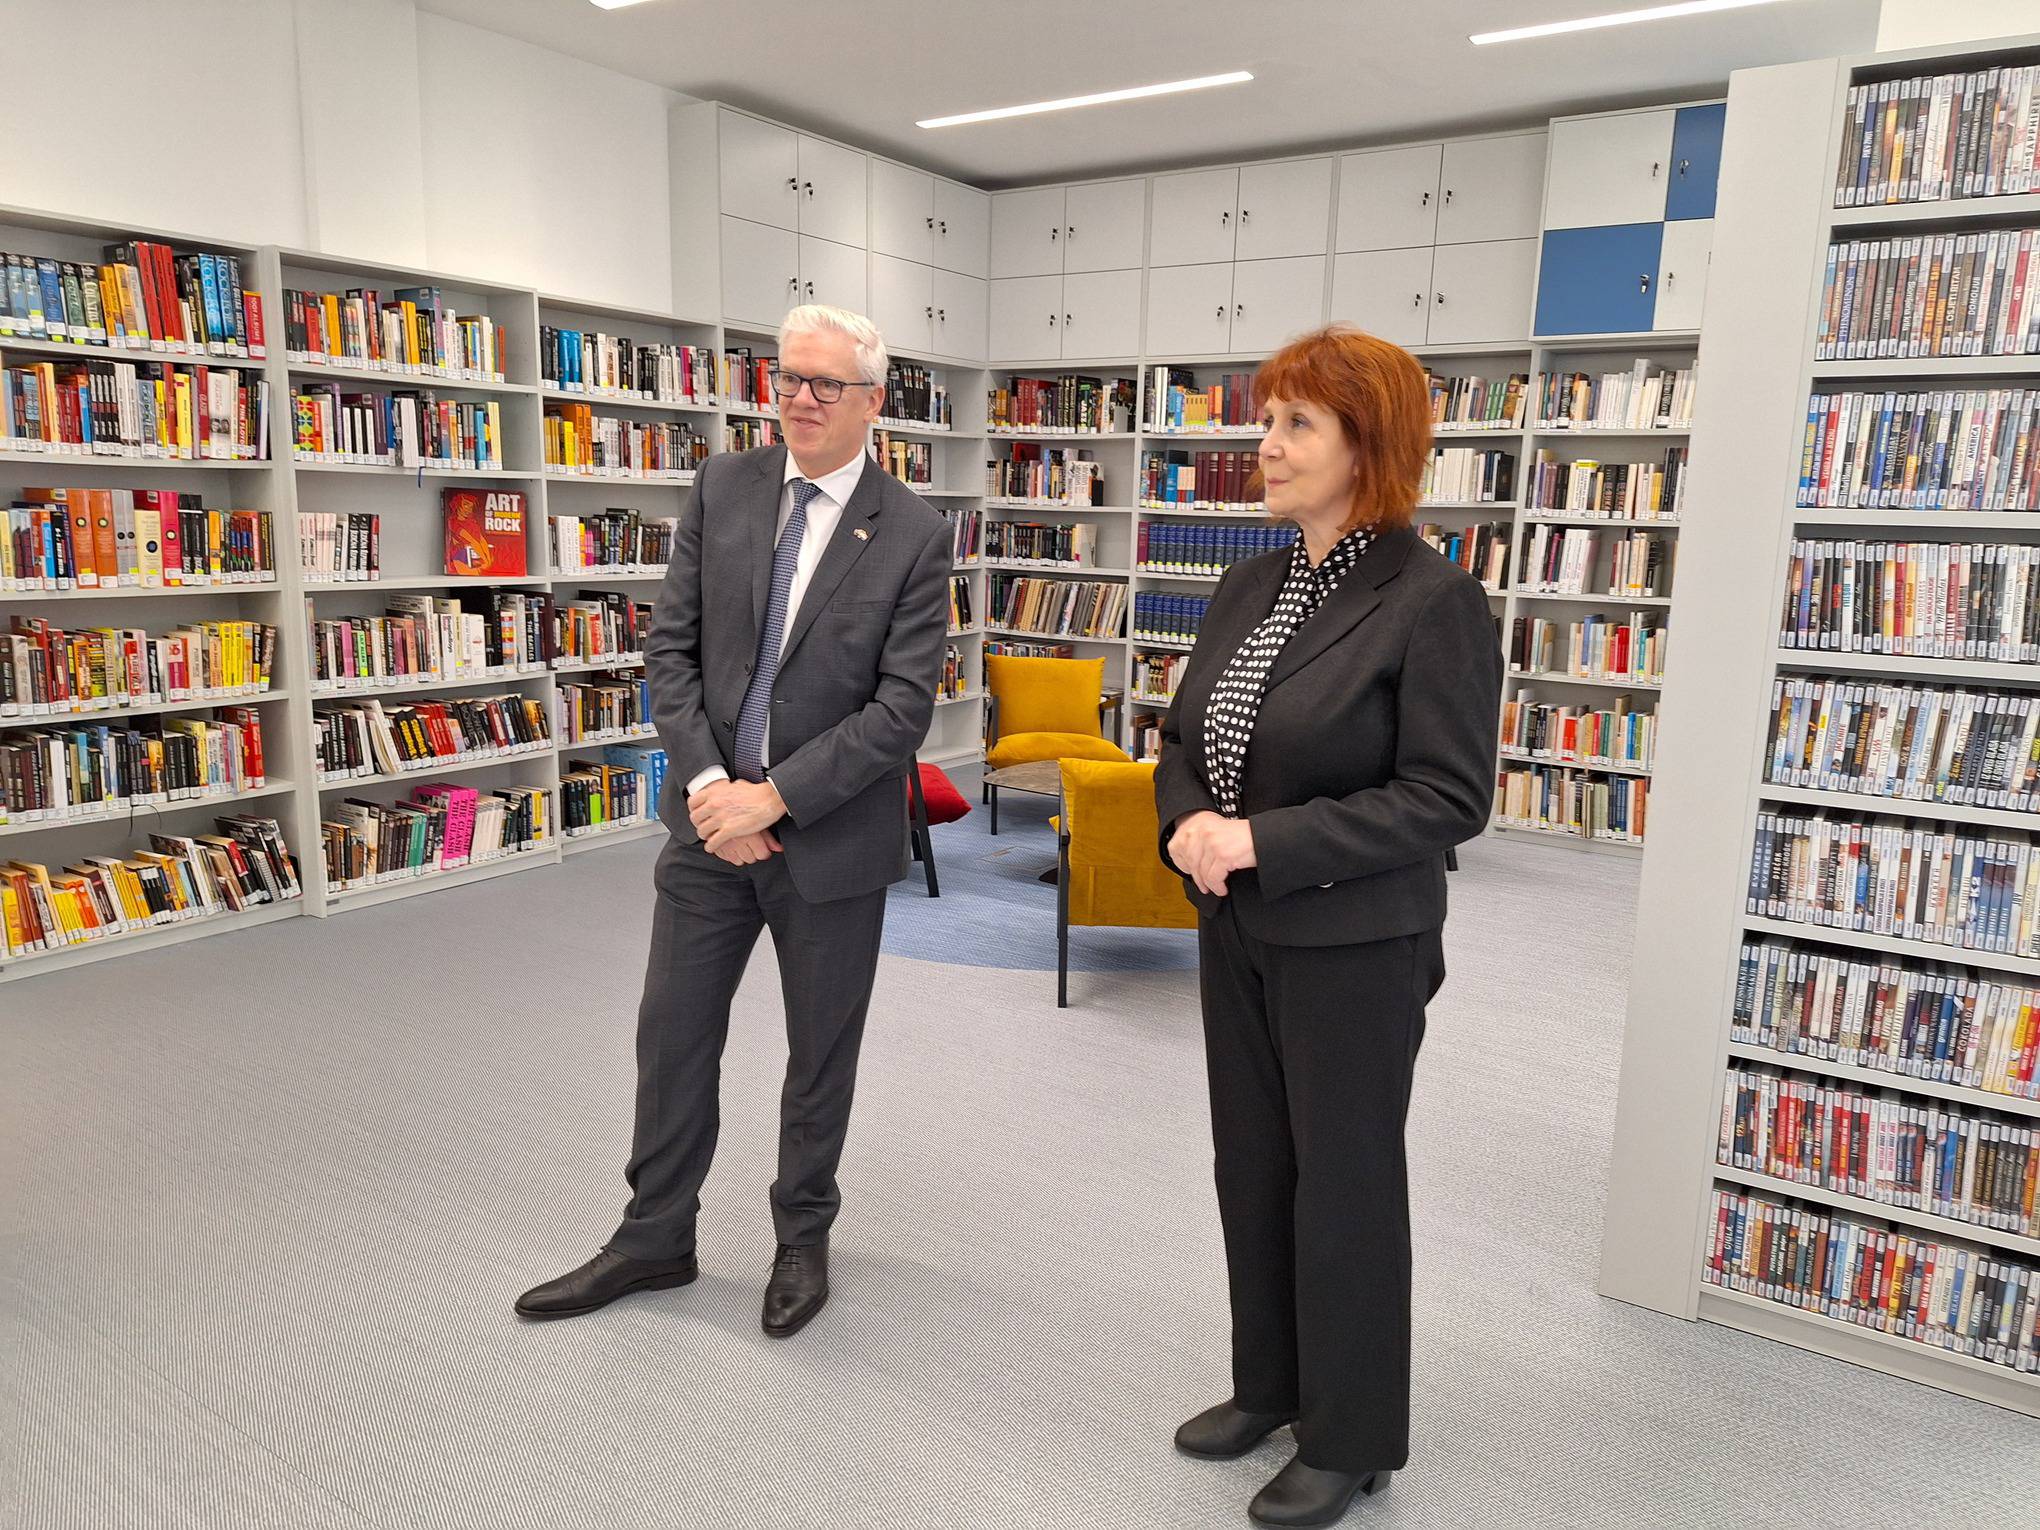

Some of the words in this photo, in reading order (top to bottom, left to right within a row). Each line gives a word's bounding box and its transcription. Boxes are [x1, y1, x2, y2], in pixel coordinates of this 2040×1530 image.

[2024, 95, 2039, 156] SAPPHIRES
[1950, 267, 1960, 292] RITAM
[1839, 276, 1854, 337] PHENOMENON
[1946, 294, 1956, 321] OSJETI
[1968, 276, 1980, 315] DOMOLJUB
[1897, 430, 1909, 465] HAVANA
[1967, 426, 1979, 459] AMERICA
[485, 493, 520, 511] ART
[485, 517, 521, 532] ROCK
[527, 635, 535, 661] BEATLES
[1900, 752, 1908, 766] LOVE
[1904, 724, 1913, 745] MERCY
[1955, 723, 1967, 752] ZLATU
[1886, 776, 1895, 791] MAX
[451, 801, 460, 820] THE
[459, 799, 467, 818] THE
[468, 797, 476, 816] THE
[447, 823, 456, 854] CLASH
[455, 821, 465, 853] CLASH
[464, 820, 474, 850] CLASH
[1751, 841, 1762, 887] EVEREST
[1761, 841, 1772, 888] EVEREST
[1772, 852, 1781, 879] DJEČAK
[1783, 842, 1791, 866] KROŠE
[1780, 868, 1788, 891] LIJEVI
[1929, 868, 1939, 907] MACBETH
[1969, 876, 1980, 897] K2
[1766, 974, 1775, 1011] DANKINJA
[1834, 986, 1844, 1013] PEHARA
[1831, 1015, 1840, 1033] VITEZ
[1938, 1018, 1949, 1043] granica
[1957, 1007, 1973, 1052] ČOKOLADA
[1735, 1125, 1745, 1137] 127
[1902, 1273, 1912, 1295] Izbori
[1923, 1273, 1933, 1292] MAJKA
[1920, 1293, 1928, 1308] NAŠA
